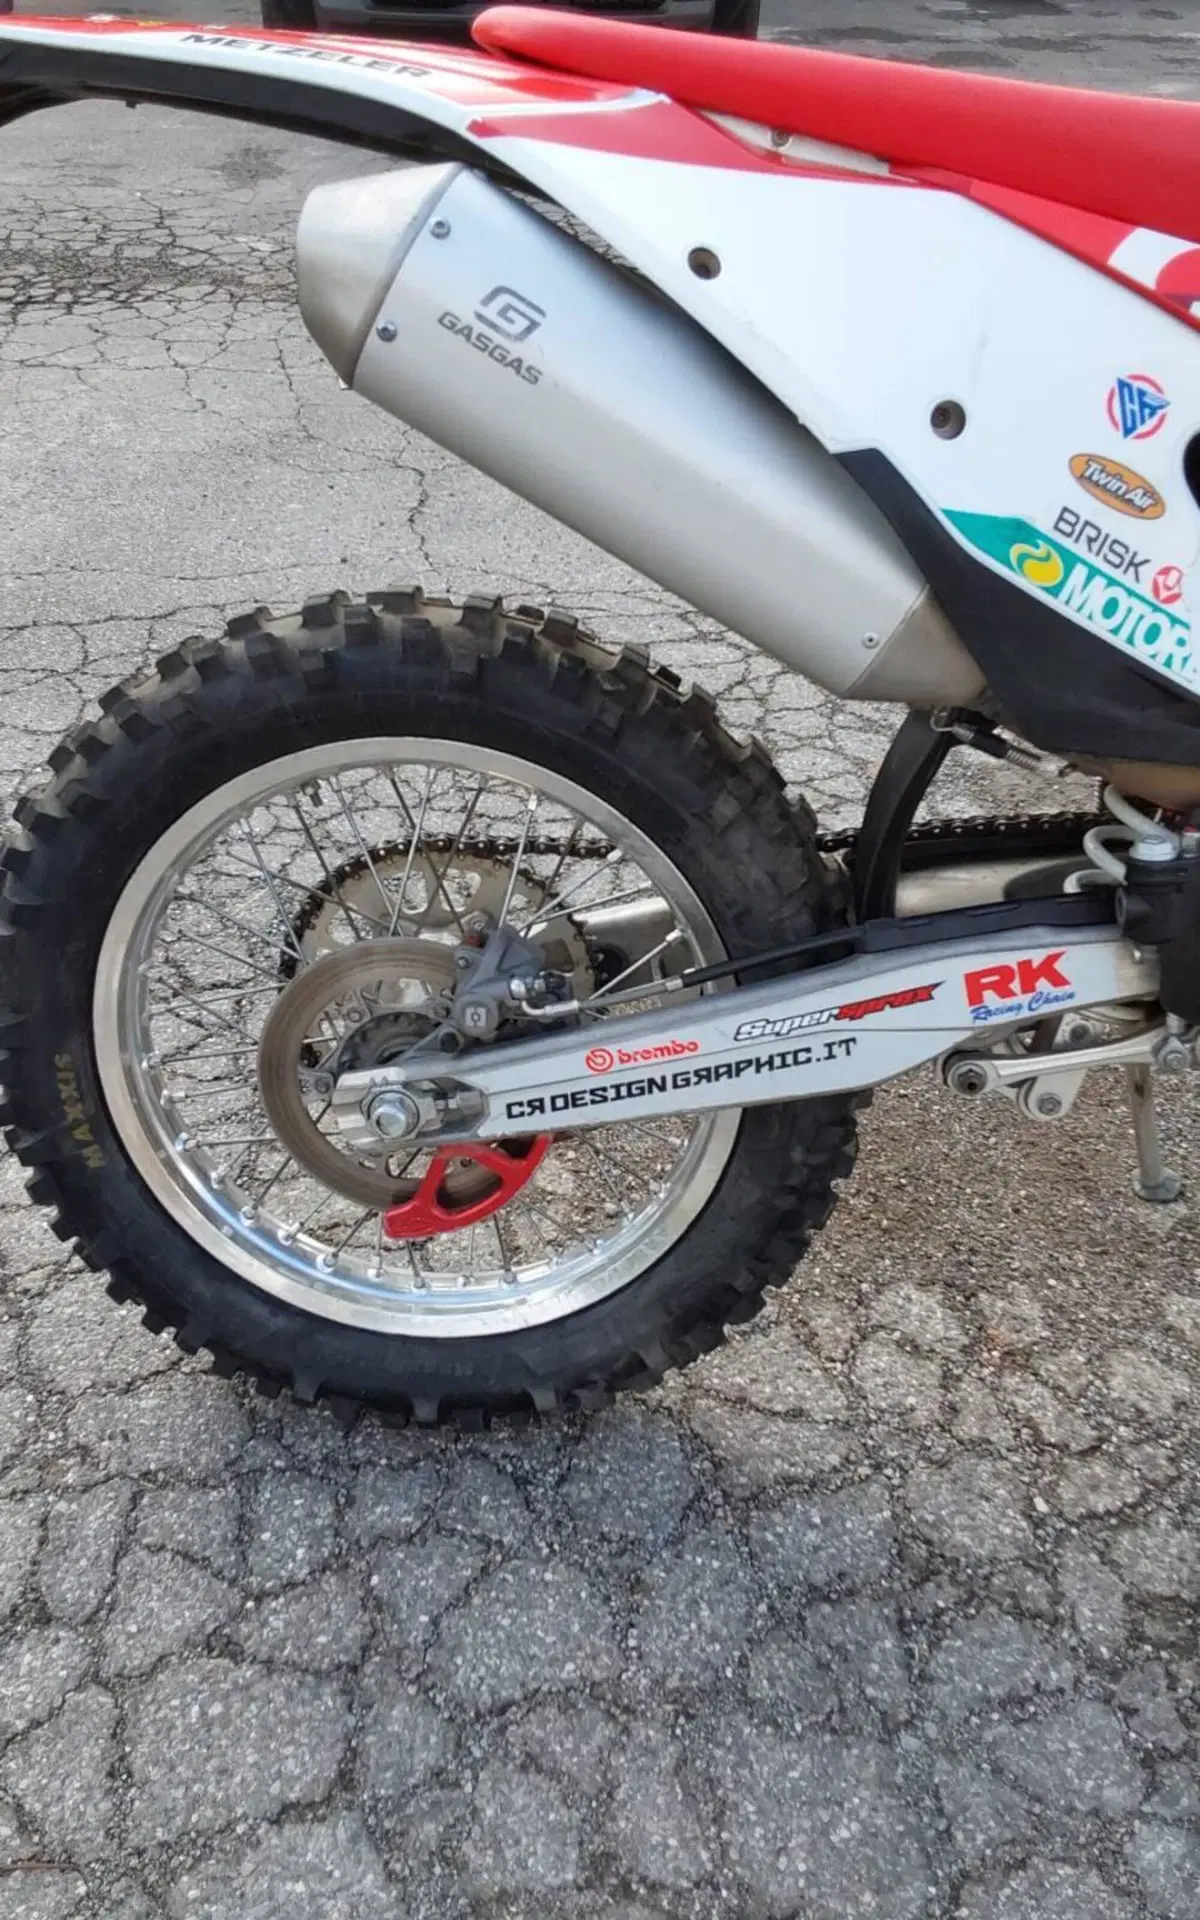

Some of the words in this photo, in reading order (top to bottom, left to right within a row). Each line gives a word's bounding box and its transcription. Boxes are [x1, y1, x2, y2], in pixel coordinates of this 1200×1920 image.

[179, 34, 432, 78] METZELER
[437, 311, 544, 385] GASGAS
[1081, 459, 1131, 497] Twin
[1124, 485, 1159, 511] Air
[1053, 506, 1151, 583] BRISK
[963, 951, 1073, 1006] RK
[969, 1002, 1024, 1025] Racing
[1027, 990, 1077, 1012] Chain
[617, 1039, 700, 1066] brembo
[54, 1053, 105, 1169] MAXXIS
[550, 1077, 669, 1112] DESIGN
